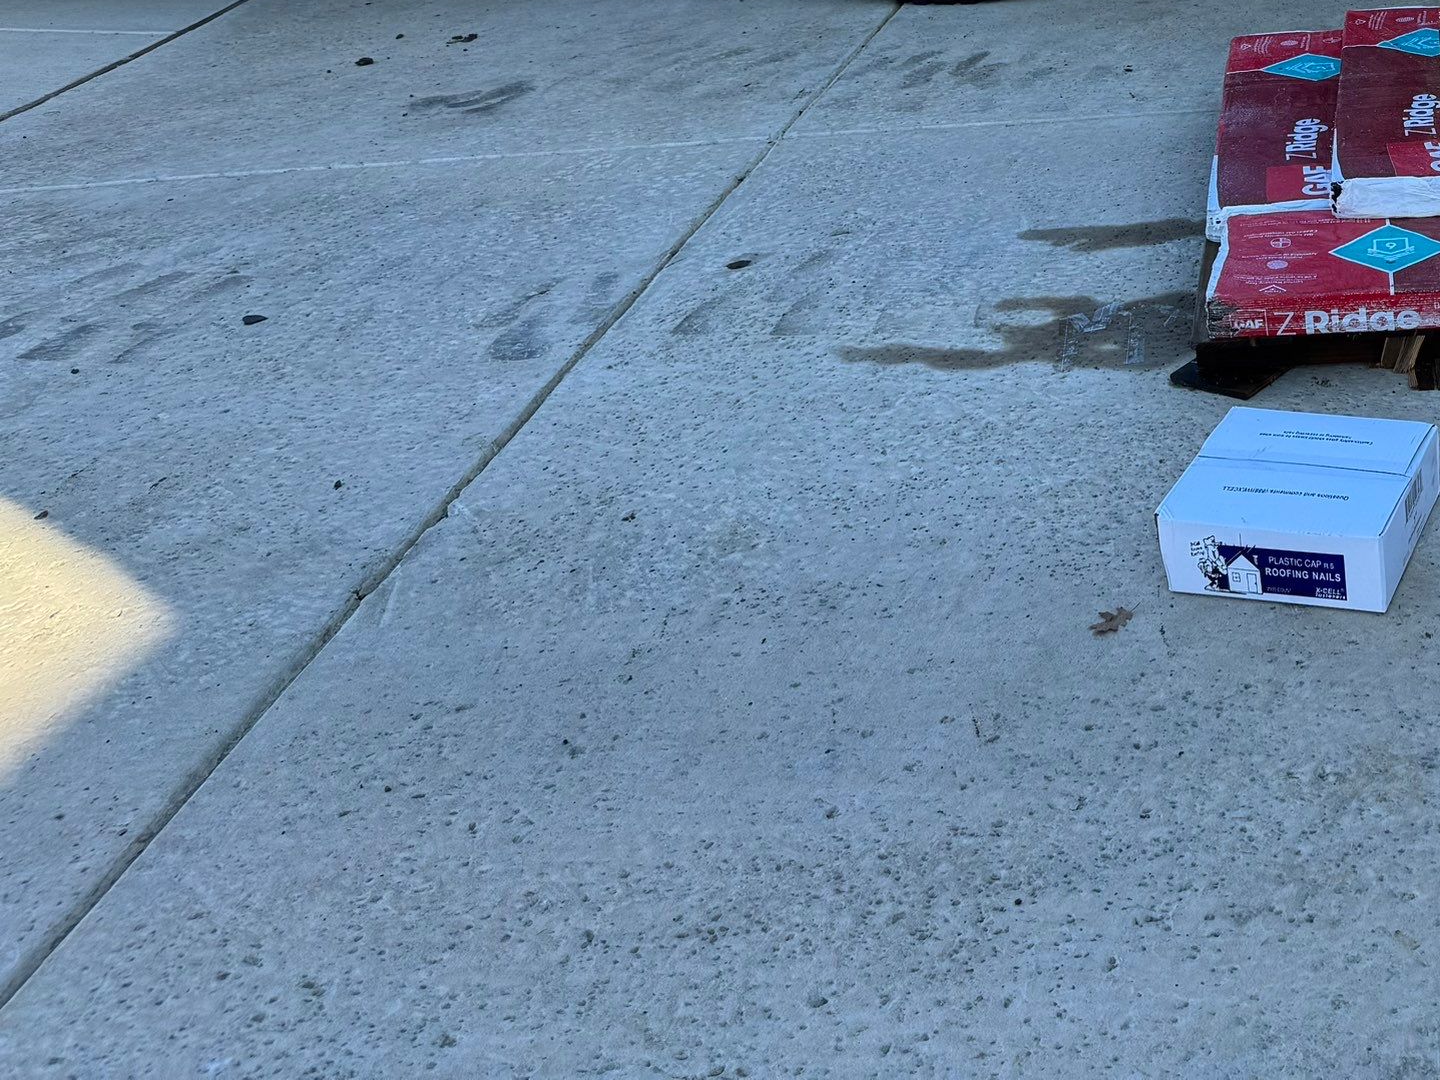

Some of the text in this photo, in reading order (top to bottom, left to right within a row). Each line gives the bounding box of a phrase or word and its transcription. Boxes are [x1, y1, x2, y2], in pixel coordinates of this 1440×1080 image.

[1286, 118, 1329, 150] Ridge
[1302, 165, 1331, 196] GAF
[1273, 311, 1297, 335] Z
[1268, 556, 1303, 567] PLASTIC
[1304, 559, 1322, 568] CAP
[1265, 567, 1341, 582] ROOFING NAILS
